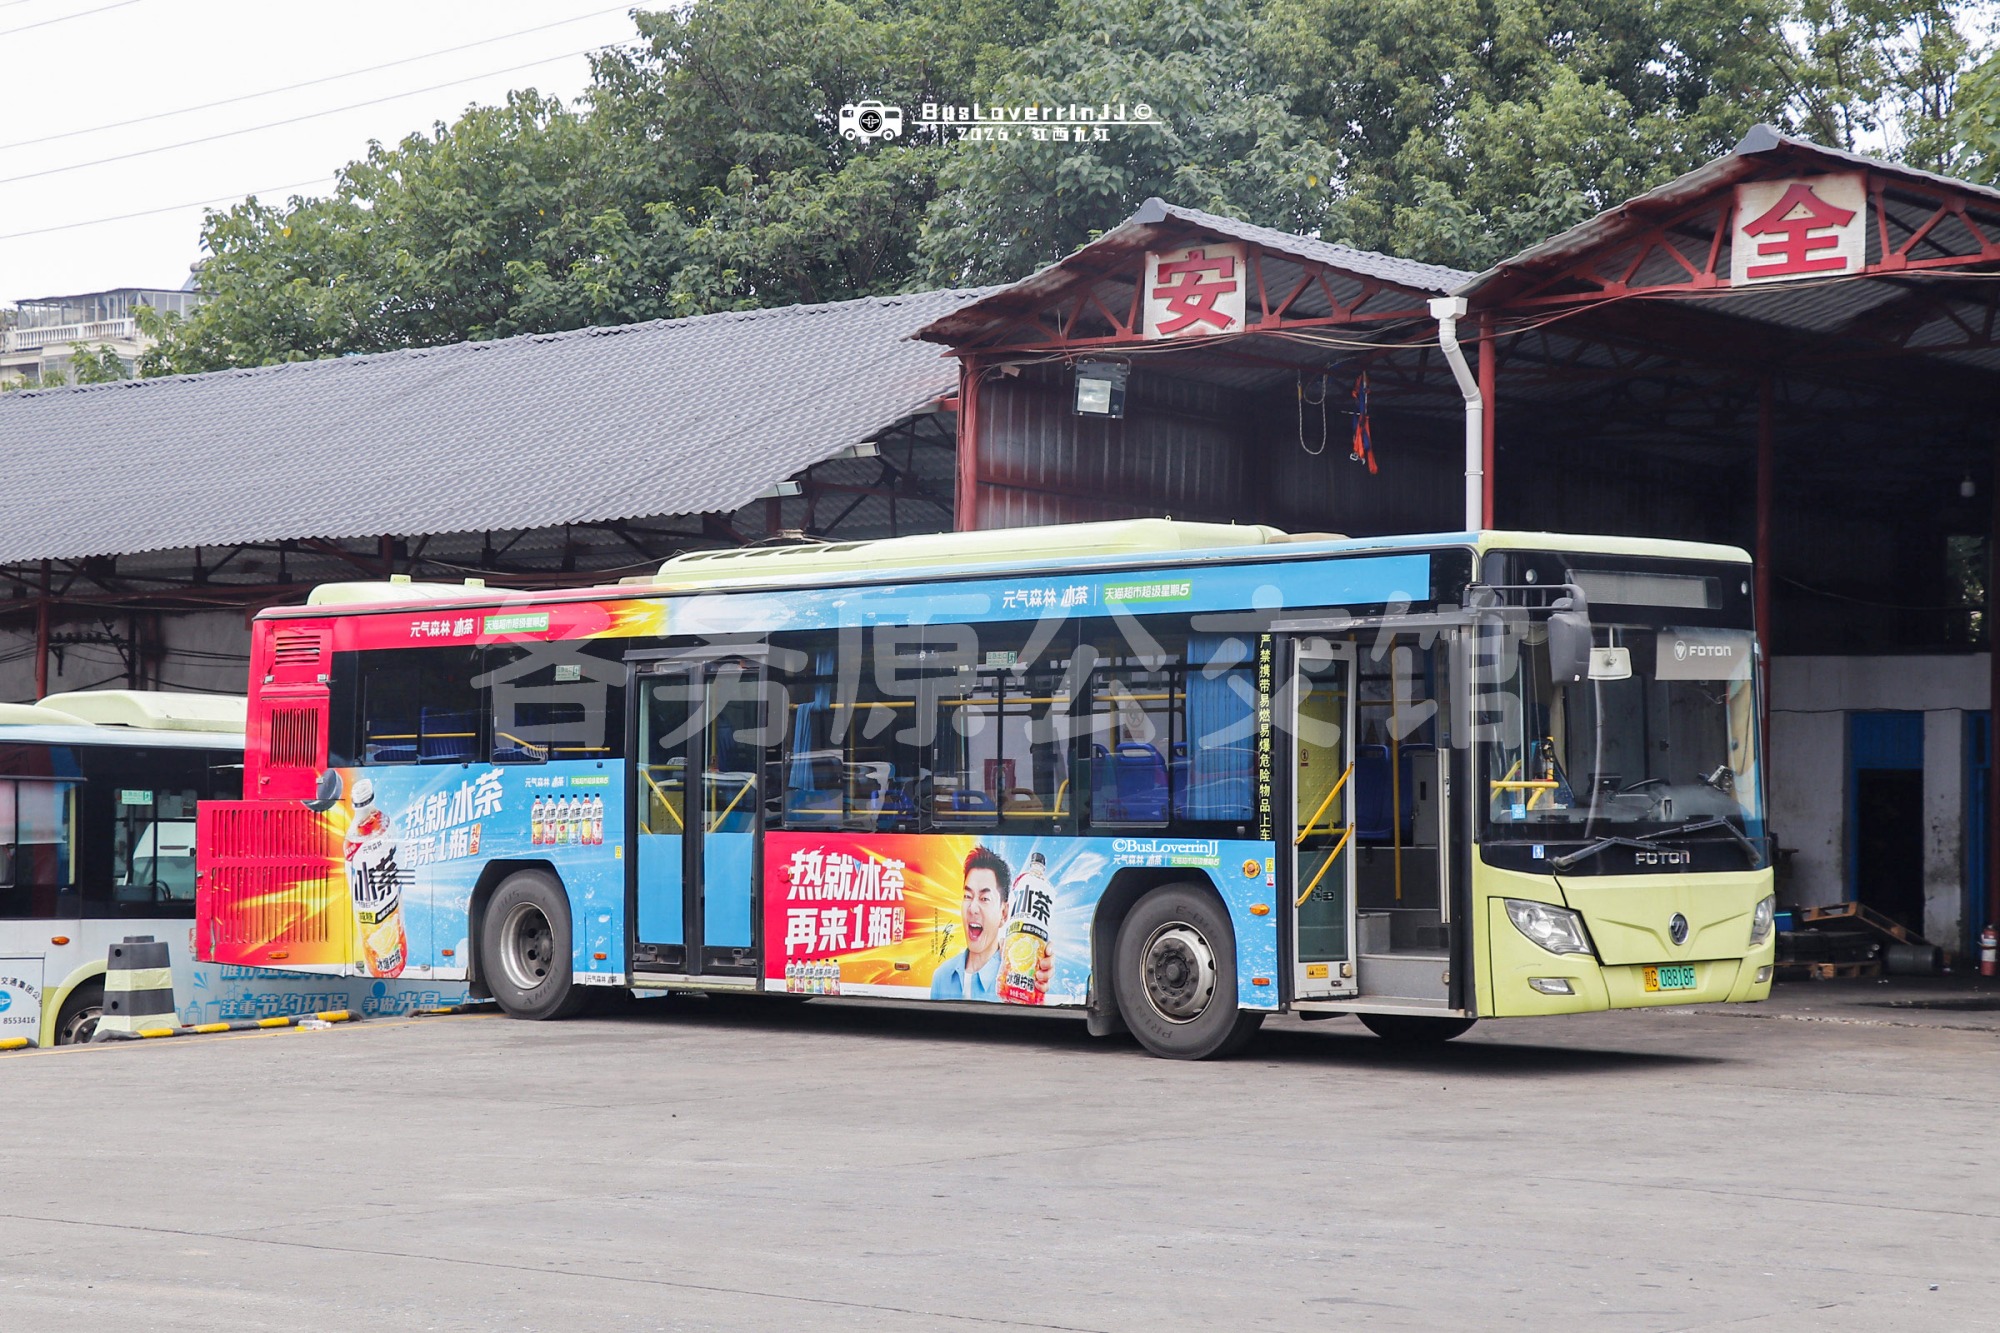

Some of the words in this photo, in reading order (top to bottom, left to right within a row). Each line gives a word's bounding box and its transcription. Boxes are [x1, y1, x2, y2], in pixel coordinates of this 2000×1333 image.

[1743, 183, 1857, 279] 全
[1152, 249, 1238, 337] 安
[1003, 589, 1057, 609] 元气森林
[1061, 584, 1088, 608] 冰茶
[1104, 583, 1190, 601] 天猫超市超级星期5
[410, 620, 451, 638] 元气森林
[1689, 645, 1732, 657] FOTON
[1259, 634, 1271, 842] 严禁携带易燃易爆危险物品上车
[404, 768, 504, 841] 热就冰茶
[404, 826, 470, 868] 再来1瓶
[1635, 850, 1691, 865] FOTON
[787, 846, 906, 900] 热就冰茶
[785, 904, 893, 955] 再来1瓶
[3, 1016, 36, 1024] 8553416
[220, 992, 349, 1019] 注重节约环保
